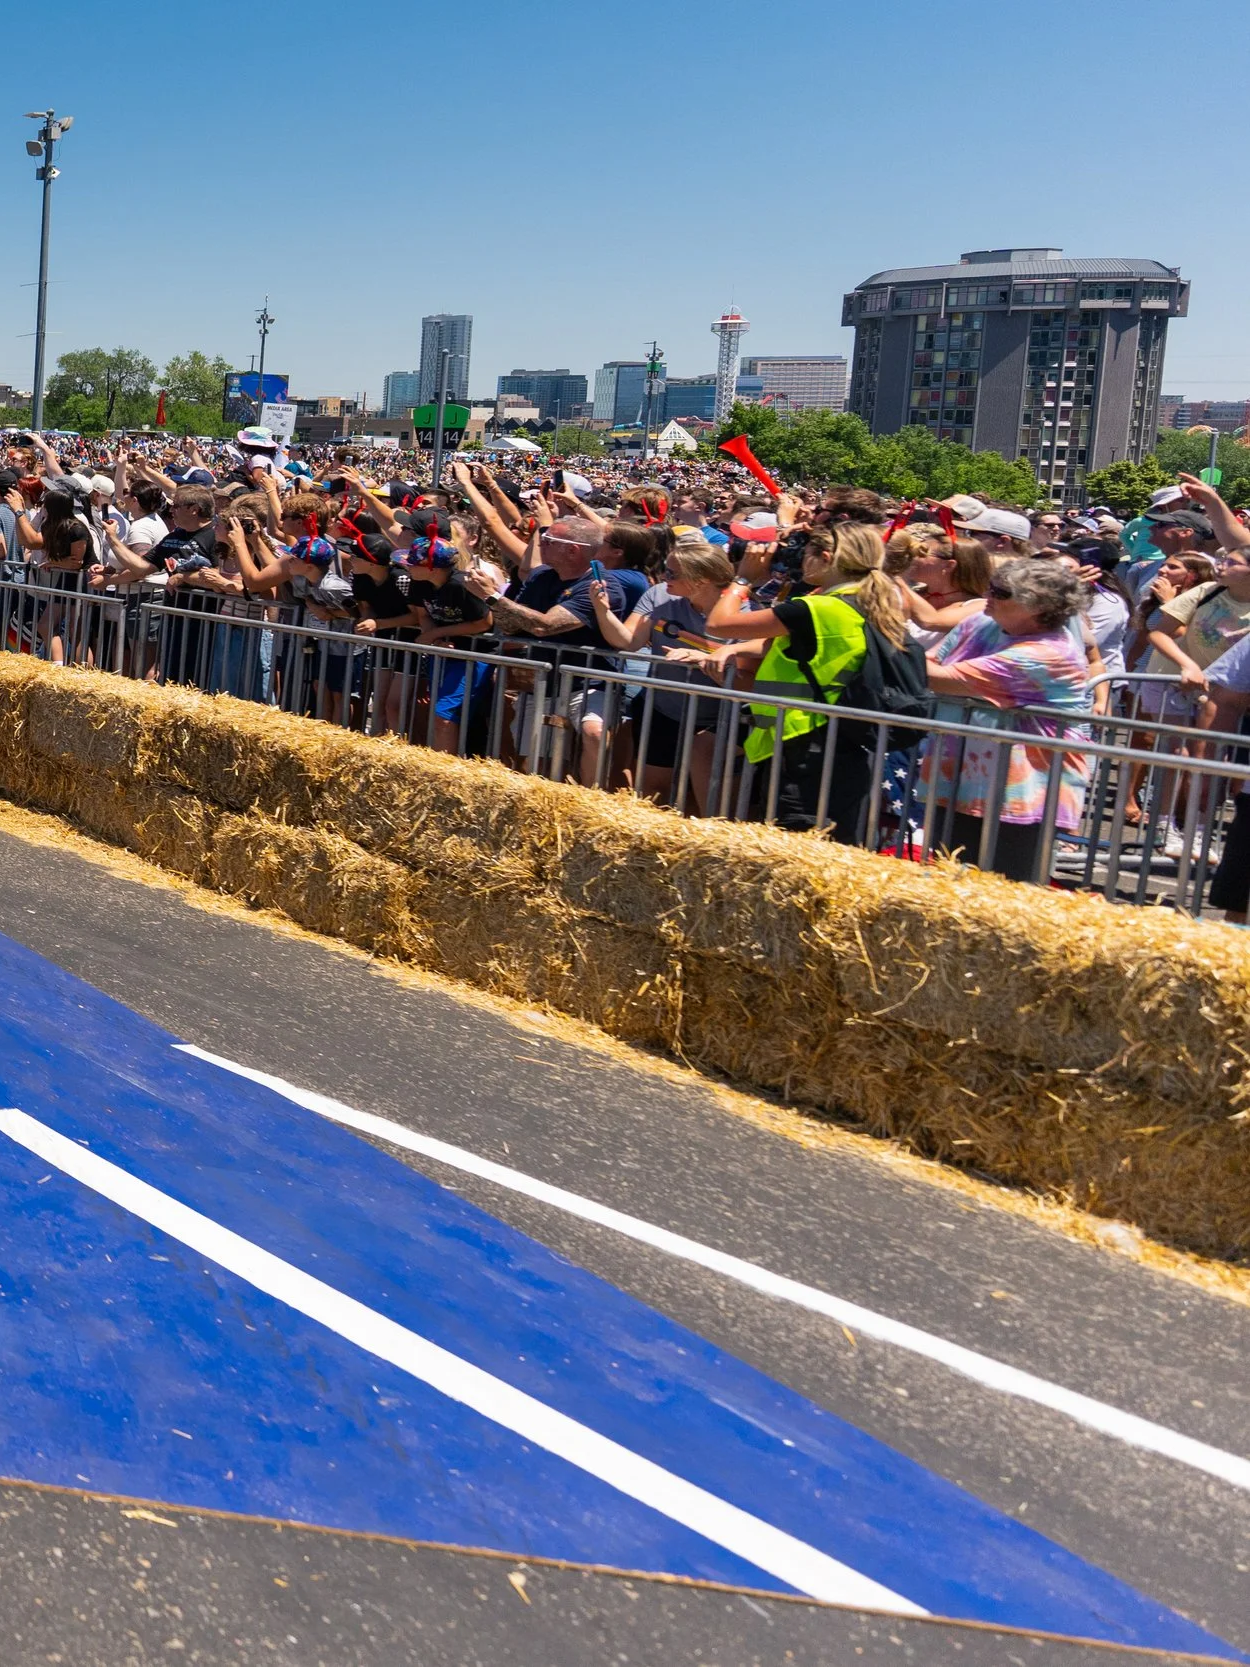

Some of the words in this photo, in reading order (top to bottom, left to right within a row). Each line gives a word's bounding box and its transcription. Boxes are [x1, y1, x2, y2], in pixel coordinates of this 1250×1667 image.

[423, 412, 432, 425] J
[450, 412, 458, 425] J
[418, 431, 433, 444] 14
[444, 431, 459, 444] 14
